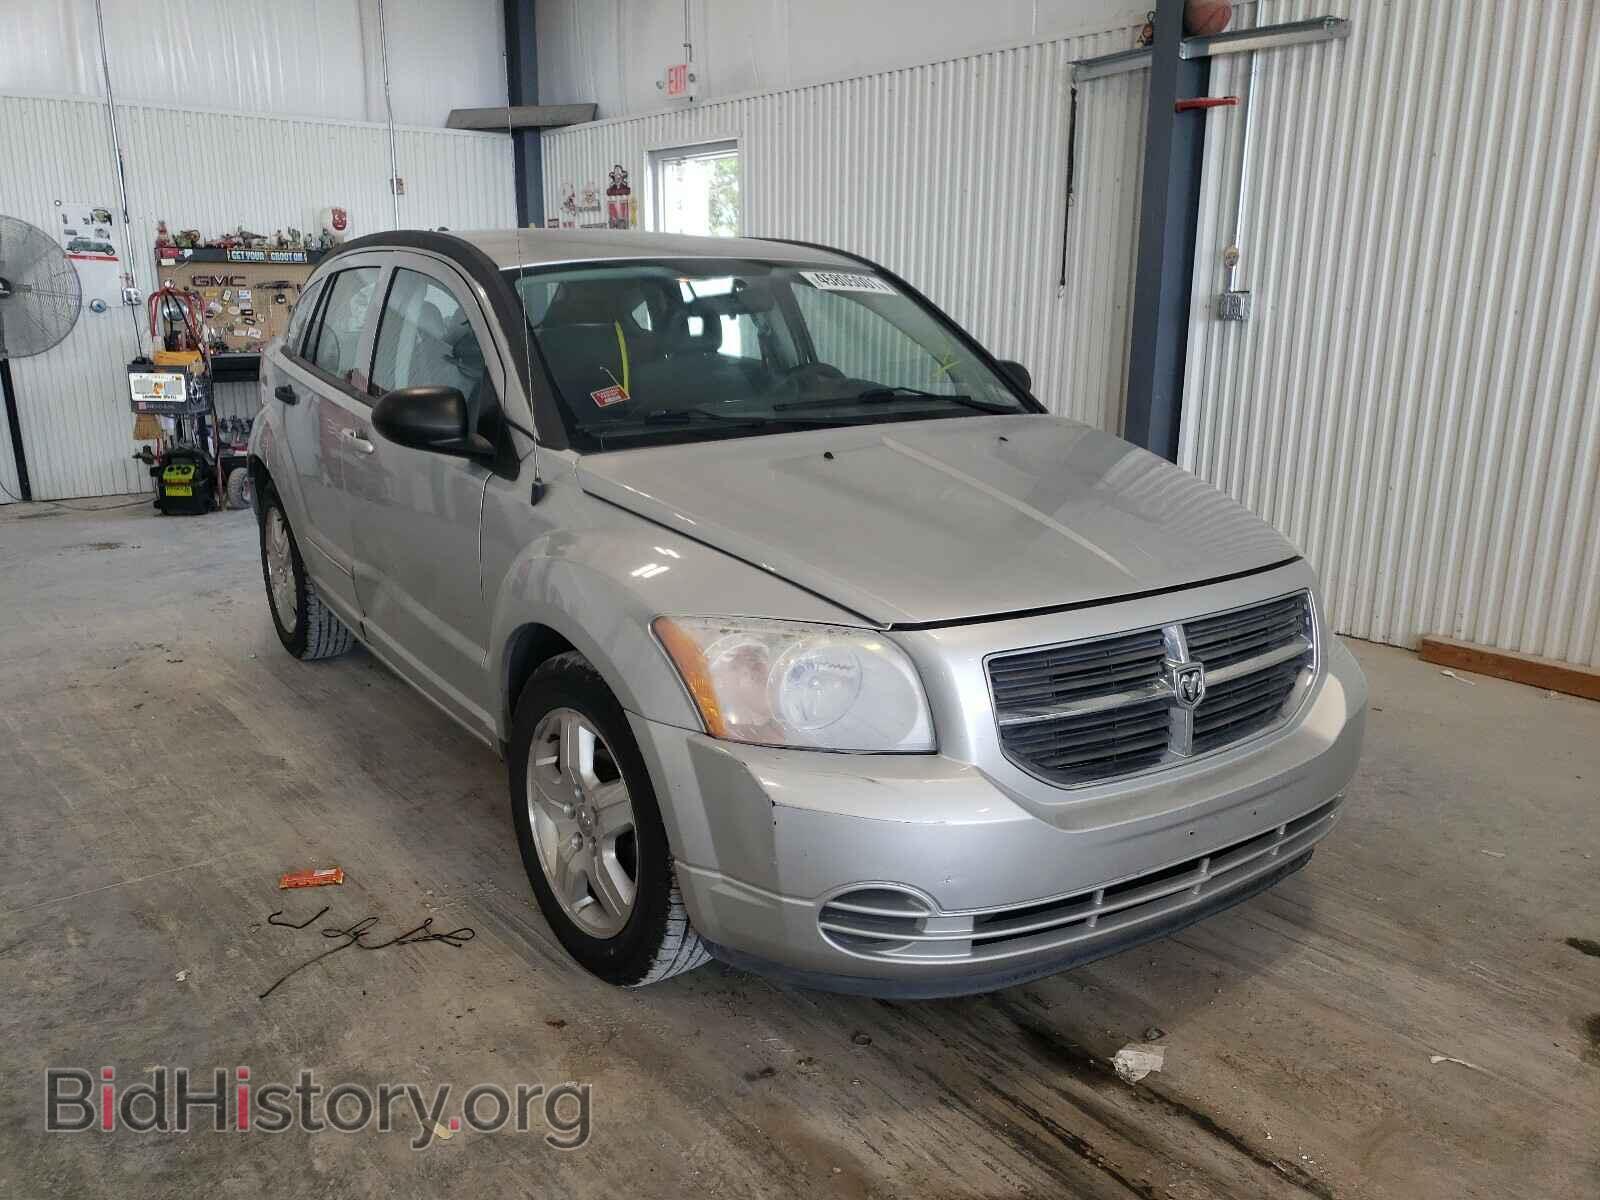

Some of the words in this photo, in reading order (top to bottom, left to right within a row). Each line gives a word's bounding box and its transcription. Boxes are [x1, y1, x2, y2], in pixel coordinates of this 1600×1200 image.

[667, 64, 688, 96] EXIT
[245, 250, 265, 261] YOUR
[191, 274, 247, 287] GMC
